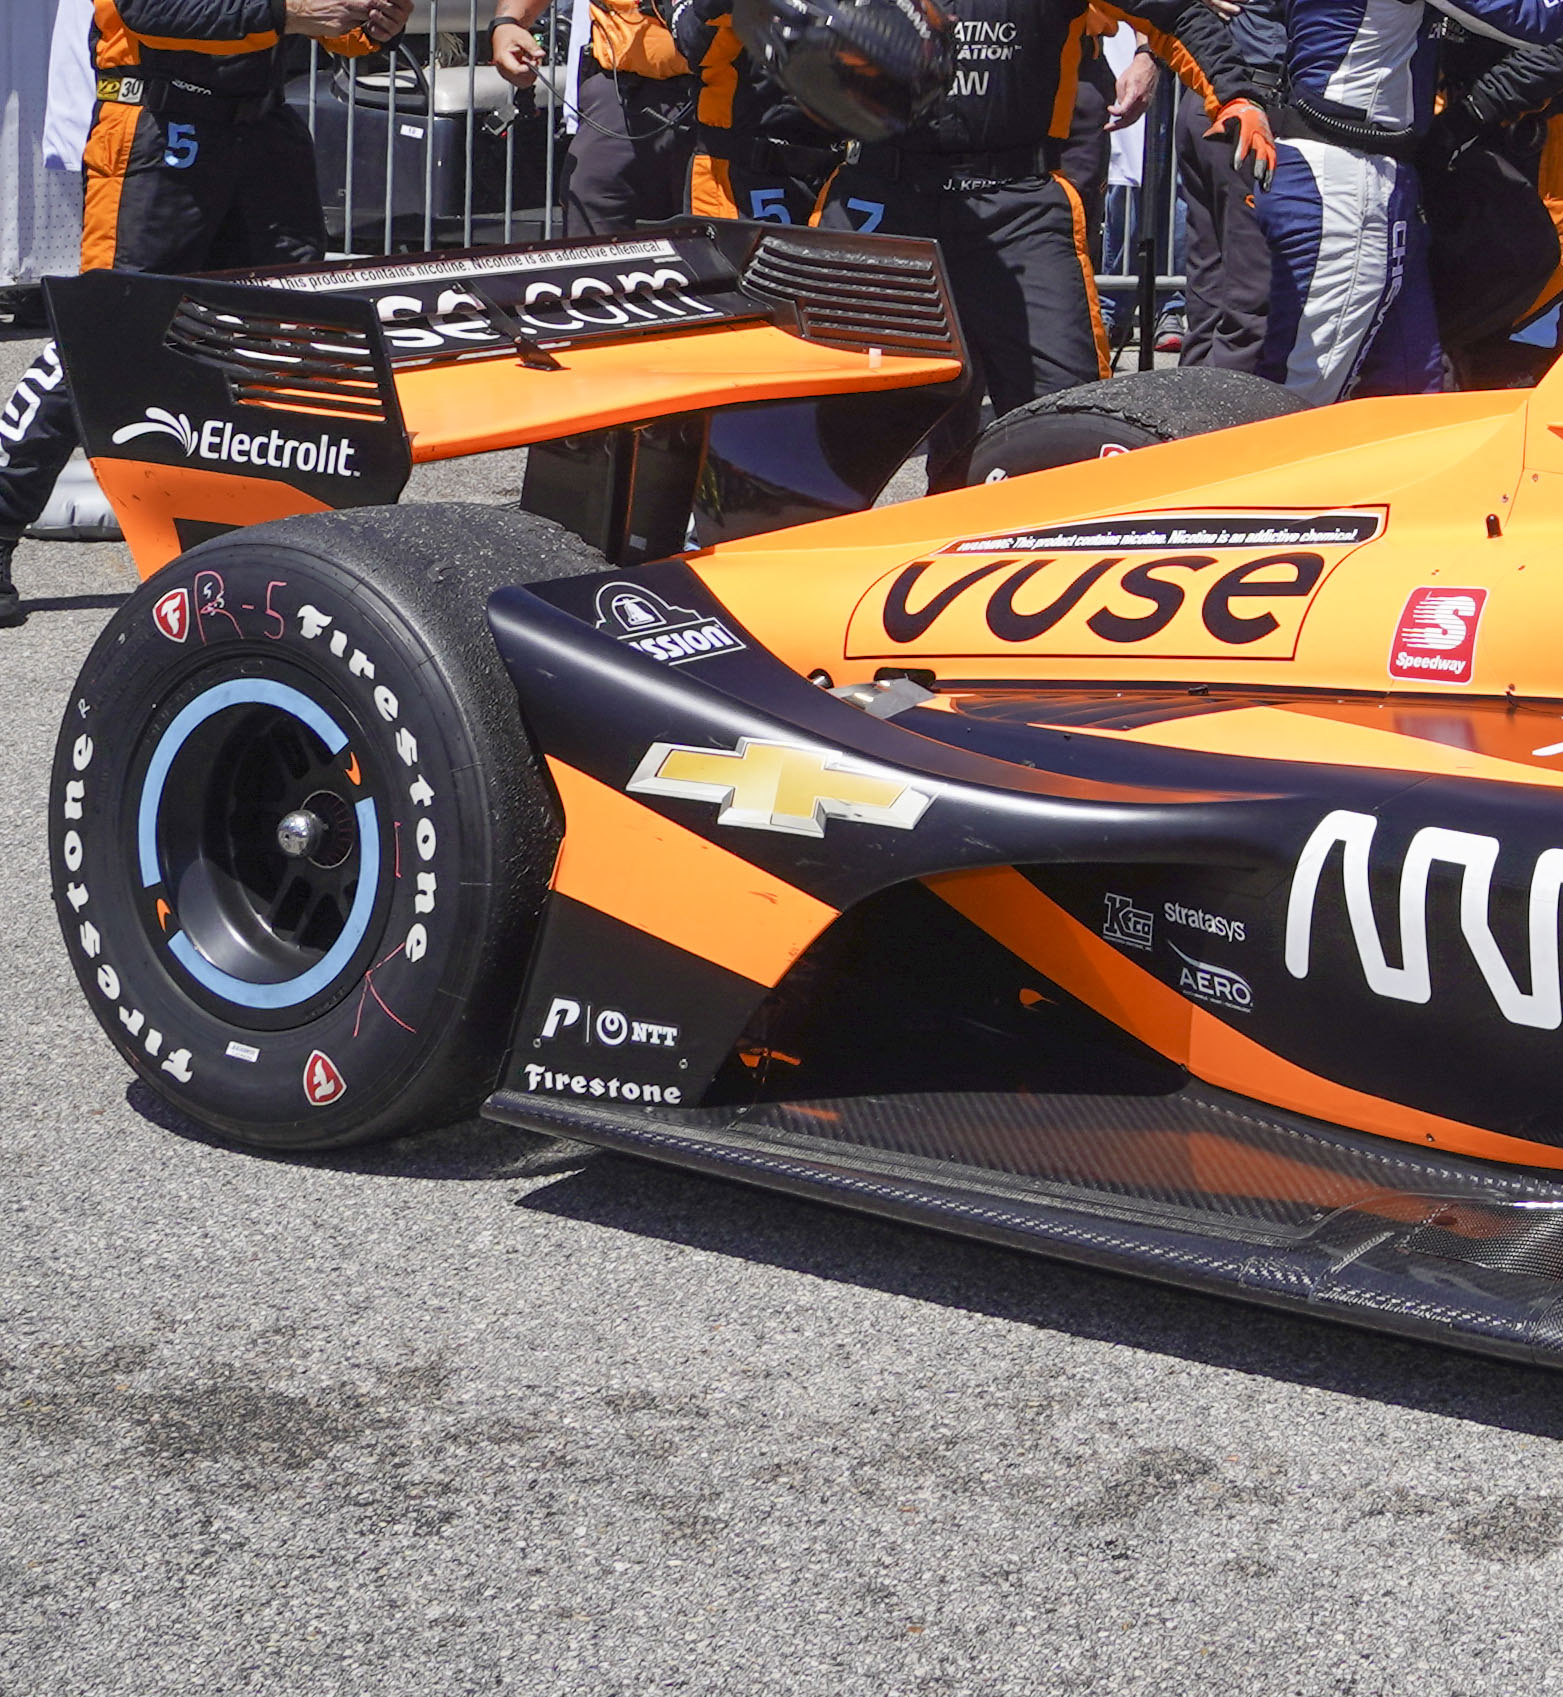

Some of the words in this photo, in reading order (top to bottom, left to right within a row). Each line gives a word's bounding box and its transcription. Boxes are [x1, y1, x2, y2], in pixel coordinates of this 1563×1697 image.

[121, 80, 141, 98] 30
[165, 123, 199, 169] 5
[750, 188, 792, 224] 5
[279, 273, 306, 291] This
[309, 270, 359, 289] product
[360, 265, 415, 283] contains
[416, 259, 469, 276] nicotine.
[471, 254, 523, 271] Nicotine
[536, 252, 552, 263] an
[555, 244, 608, 262] addictive
[609, 239, 665, 256] chemical.
[201, 420, 357, 478] Electrolit
[1034, 534, 1076, 550] product
[1076, 532, 1120, 547] contains
[1169, 529, 1217, 545] Nicotine
[1246, 528, 1299, 544] addictive
[881, 553, 1326, 644] vuse
[1395, 651, 1467, 675] Speedway
[296, 604, 439, 964] Firestone
[62, 733, 194, 1086] Firestone
[1163, 902, 1246, 943] stratasys
[1179, 967, 1252, 1005] AERO
[630, 1023, 679, 1047] NTT
[523, 1062, 682, 1104] Firestone
